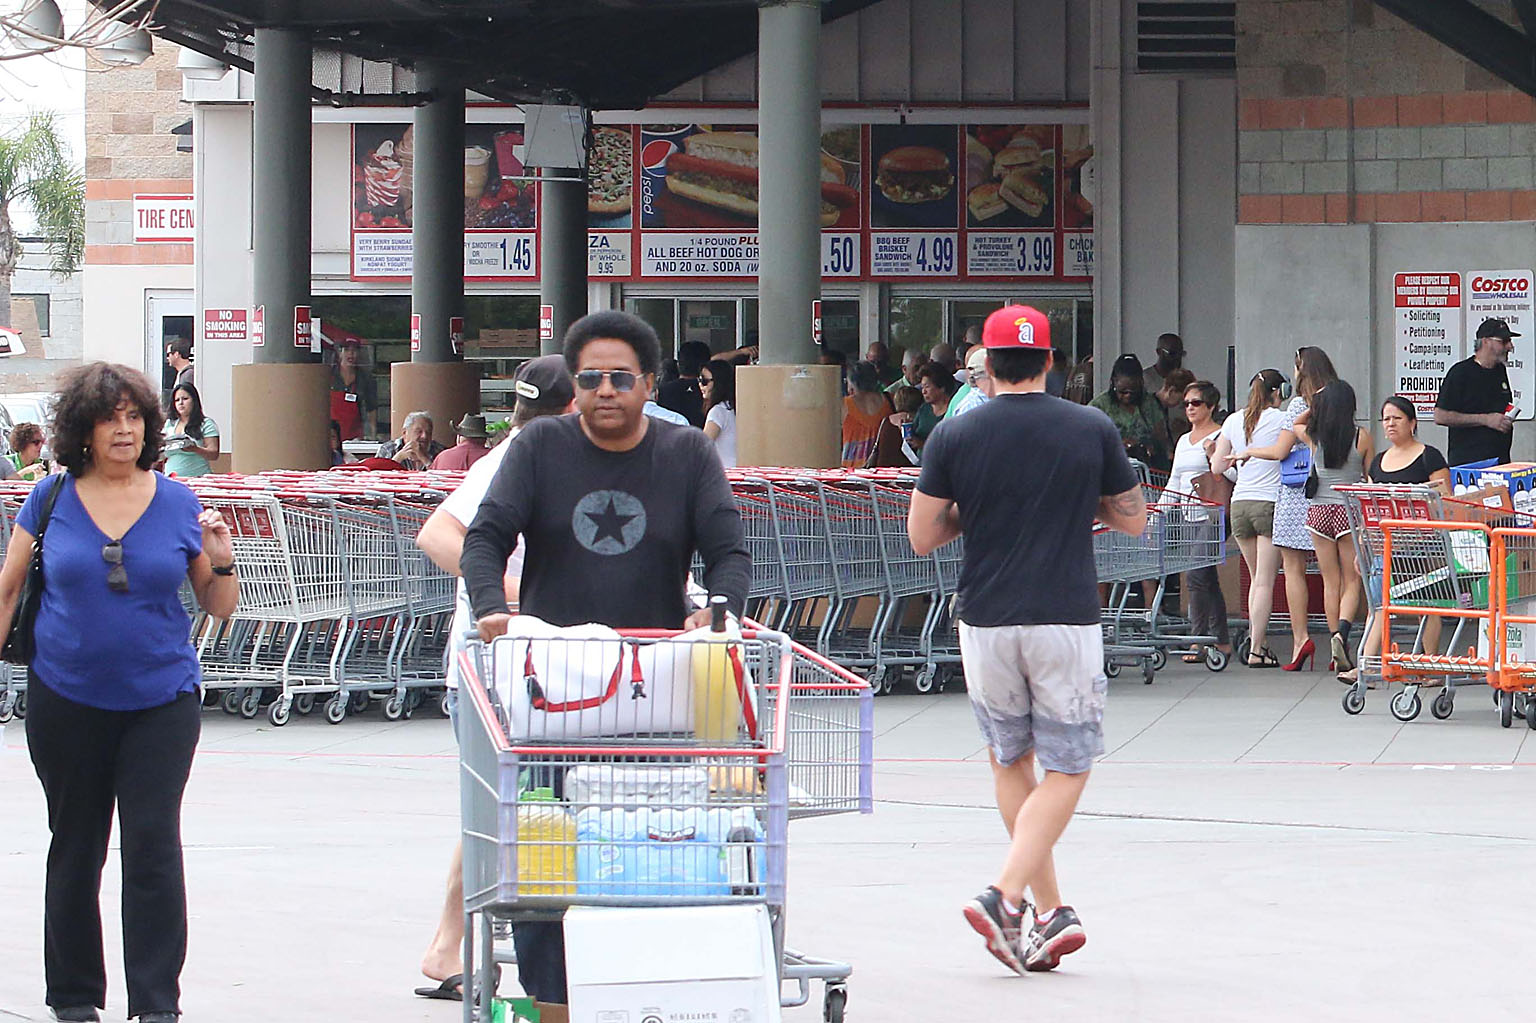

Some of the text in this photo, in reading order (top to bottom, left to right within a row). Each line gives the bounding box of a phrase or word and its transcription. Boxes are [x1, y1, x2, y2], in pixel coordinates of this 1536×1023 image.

[643, 177, 654, 214] pepsi
[137, 209, 165, 228] TIRE
[589, 235, 610, 248] ZA
[705, 238, 737, 246] POUND
[876, 237, 891, 245] BBQ
[500, 238, 531, 270] 1.45
[648, 247, 759, 258] ALL BEEF HOT DOG OR
[824, 237, 854, 272] .50
[878, 245, 908, 253] BRISKET
[916, 237, 954, 272] 4.99
[1017, 237, 1052, 271] 3.99
[875, 253, 912, 261] SANDWICH
[598, 262, 614, 274] 9.95
[655, 261, 677, 272] AND
[680, 261, 692, 272] 20
[695, 262, 709, 272] oz.
[713, 261, 741, 272] SODA
[219, 311, 233, 320] NO
[1409, 310, 1440, 322] Soliciting
[205, 321, 246, 331] SMOKING
[1409, 326, 1445, 339] Petitioning
[1409, 342, 1452, 356] Campaigning
[1409, 359, 1444, 372] Leafletting
